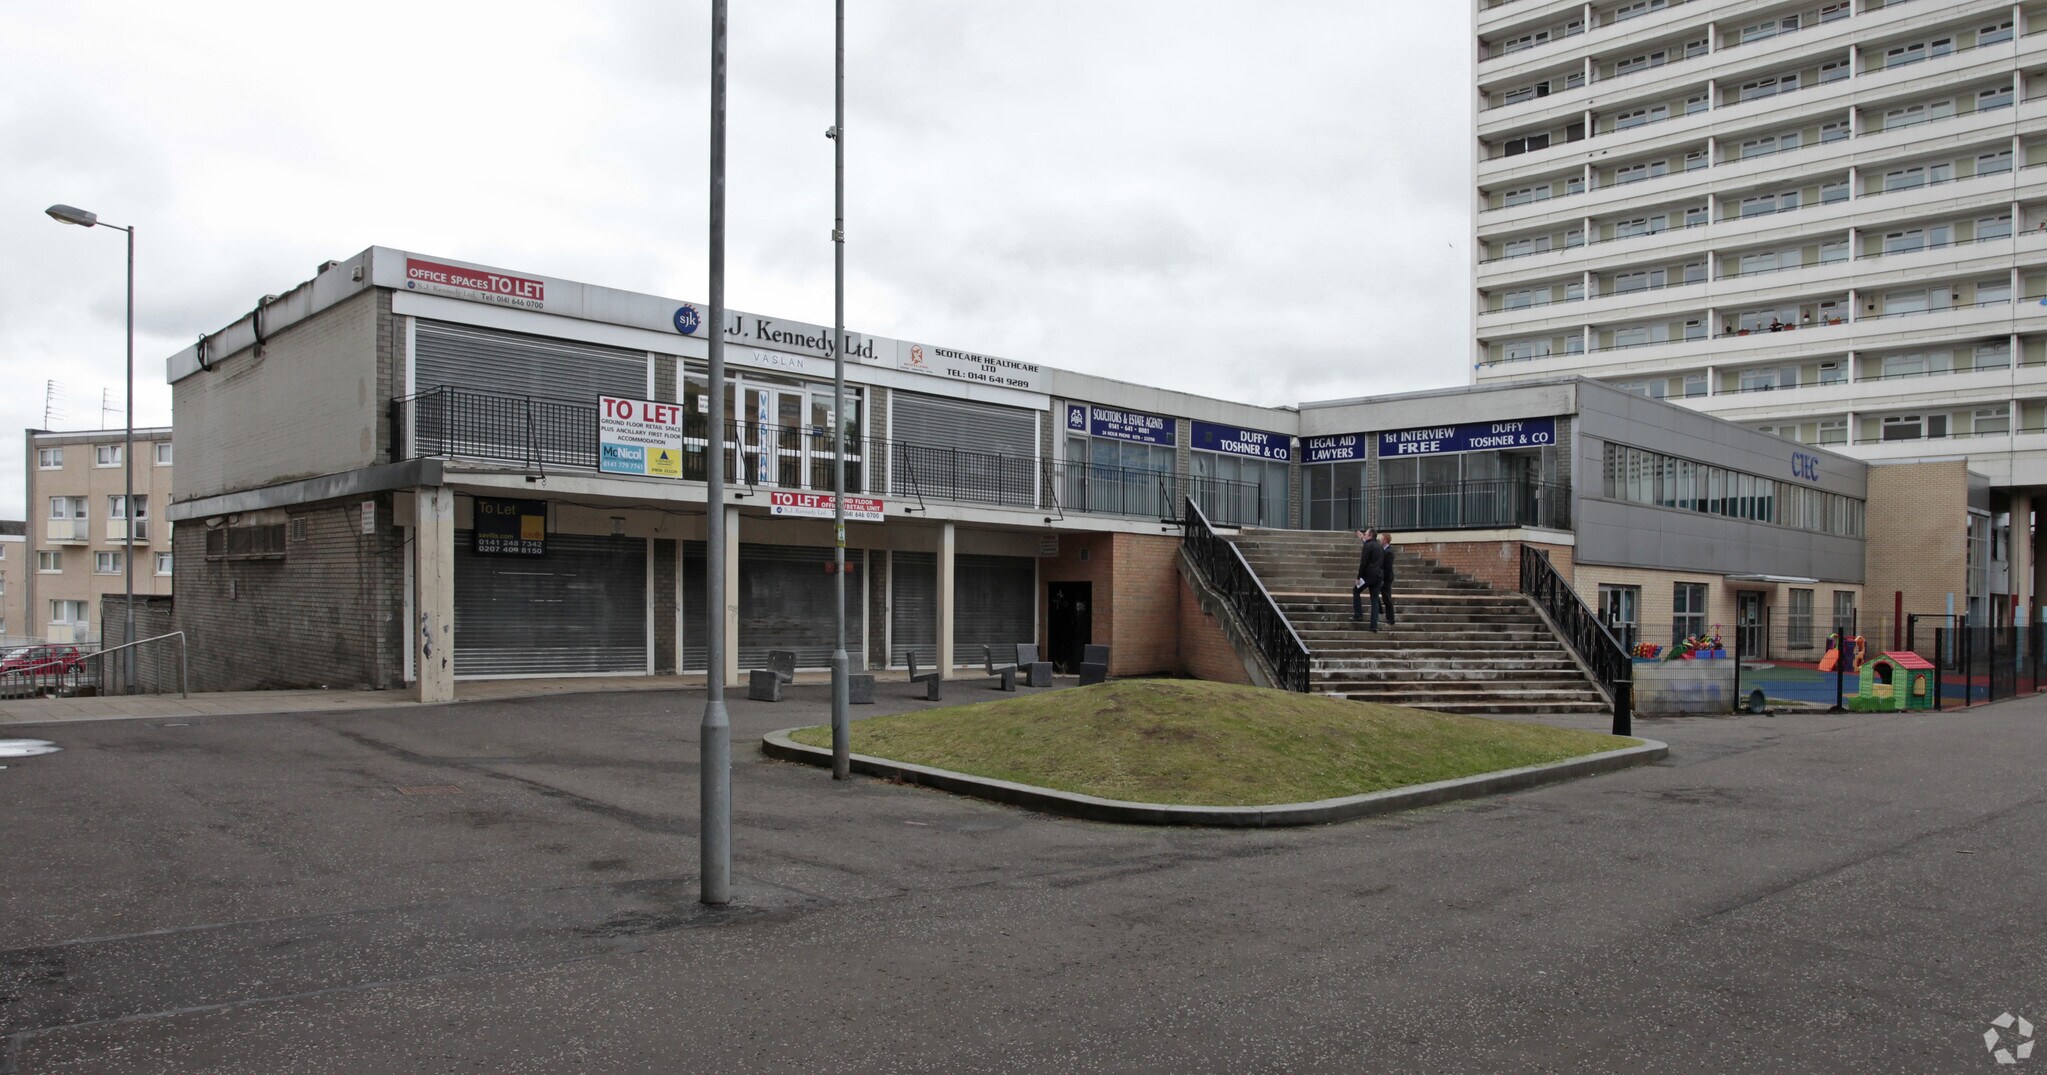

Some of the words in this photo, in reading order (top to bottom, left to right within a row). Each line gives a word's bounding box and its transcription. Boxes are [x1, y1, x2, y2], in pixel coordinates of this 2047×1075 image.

[409, 268, 447, 283] OFFICE
[451, 275, 488, 290] SPACES
[488, 276, 512, 293] TO
[516, 280, 544, 298] LET
[481, 292, 494, 300] Tel:
[496, 296, 510, 304] 0141
[512, 298, 524, 306] 646
[526, 301, 544, 310] 0700
[680, 312, 697, 328] sjk
[724, 316, 748, 337] .J.
[756, 319, 836, 357] Kennedy
[844, 335, 878, 360] Ltd.
[753, 352, 804, 368] VASLAN
[935, 348, 982, 364] SCOTCARE
[984, 356, 1039, 373] HEALTHCARE
[982, 364, 996, 373] LTD
[947, 368, 966, 378] TEL:
[968, 372, 986, 381] 0141
[989, 375, 1004, 384] 641
[1006, 378, 1029, 388] 9289
[603, 398, 632, 420] TO
[643, 404, 680, 425] LET
[1094, 408, 1122, 423] SOLICITORS
[1123, 414, 1128, 424] &
[1129, 414, 1144, 426] ESTATE
[1146, 416, 1164, 430] AGENTS
[601, 418, 624, 426] GROUND
[1492, 422, 1524, 434] DUFFY
[616, 428, 646, 436] ANCILLARY
[760, 394, 768, 482] VASLAN
[1240, 430, 1268, 444] DUFFY
[1384, 432, 1397, 443] 1st
[1400, 428, 1456, 442] INTERVIEW
[618, 436, 666, 445] ACCOMMODATION
[1310, 438, 1336, 448] LEGAL
[1339, 436, 1356, 446] AID
[1398, 440, 1440, 454] FREE
[1469, 434, 1514, 448] TOSHNER
[1520, 434, 1528, 444] &
[1532, 432, 1549, 443] CO
[604, 446, 642, 460] McNicol
[1220, 440, 1260, 455] TOSHNER
[1264, 446, 1270, 456] &
[1274, 448, 1287, 459] CO
[1312, 447, 1354, 460] LAWYERS
[774, 493, 793, 505] TO
[798, 494, 820, 508] LET
[828, 496, 854, 504] GRND
[478, 502, 492, 514] To
[496, 504, 516, 515] Let
[478, 538, 500, 546] 0141
[522, 540, 542, 548] 7342
